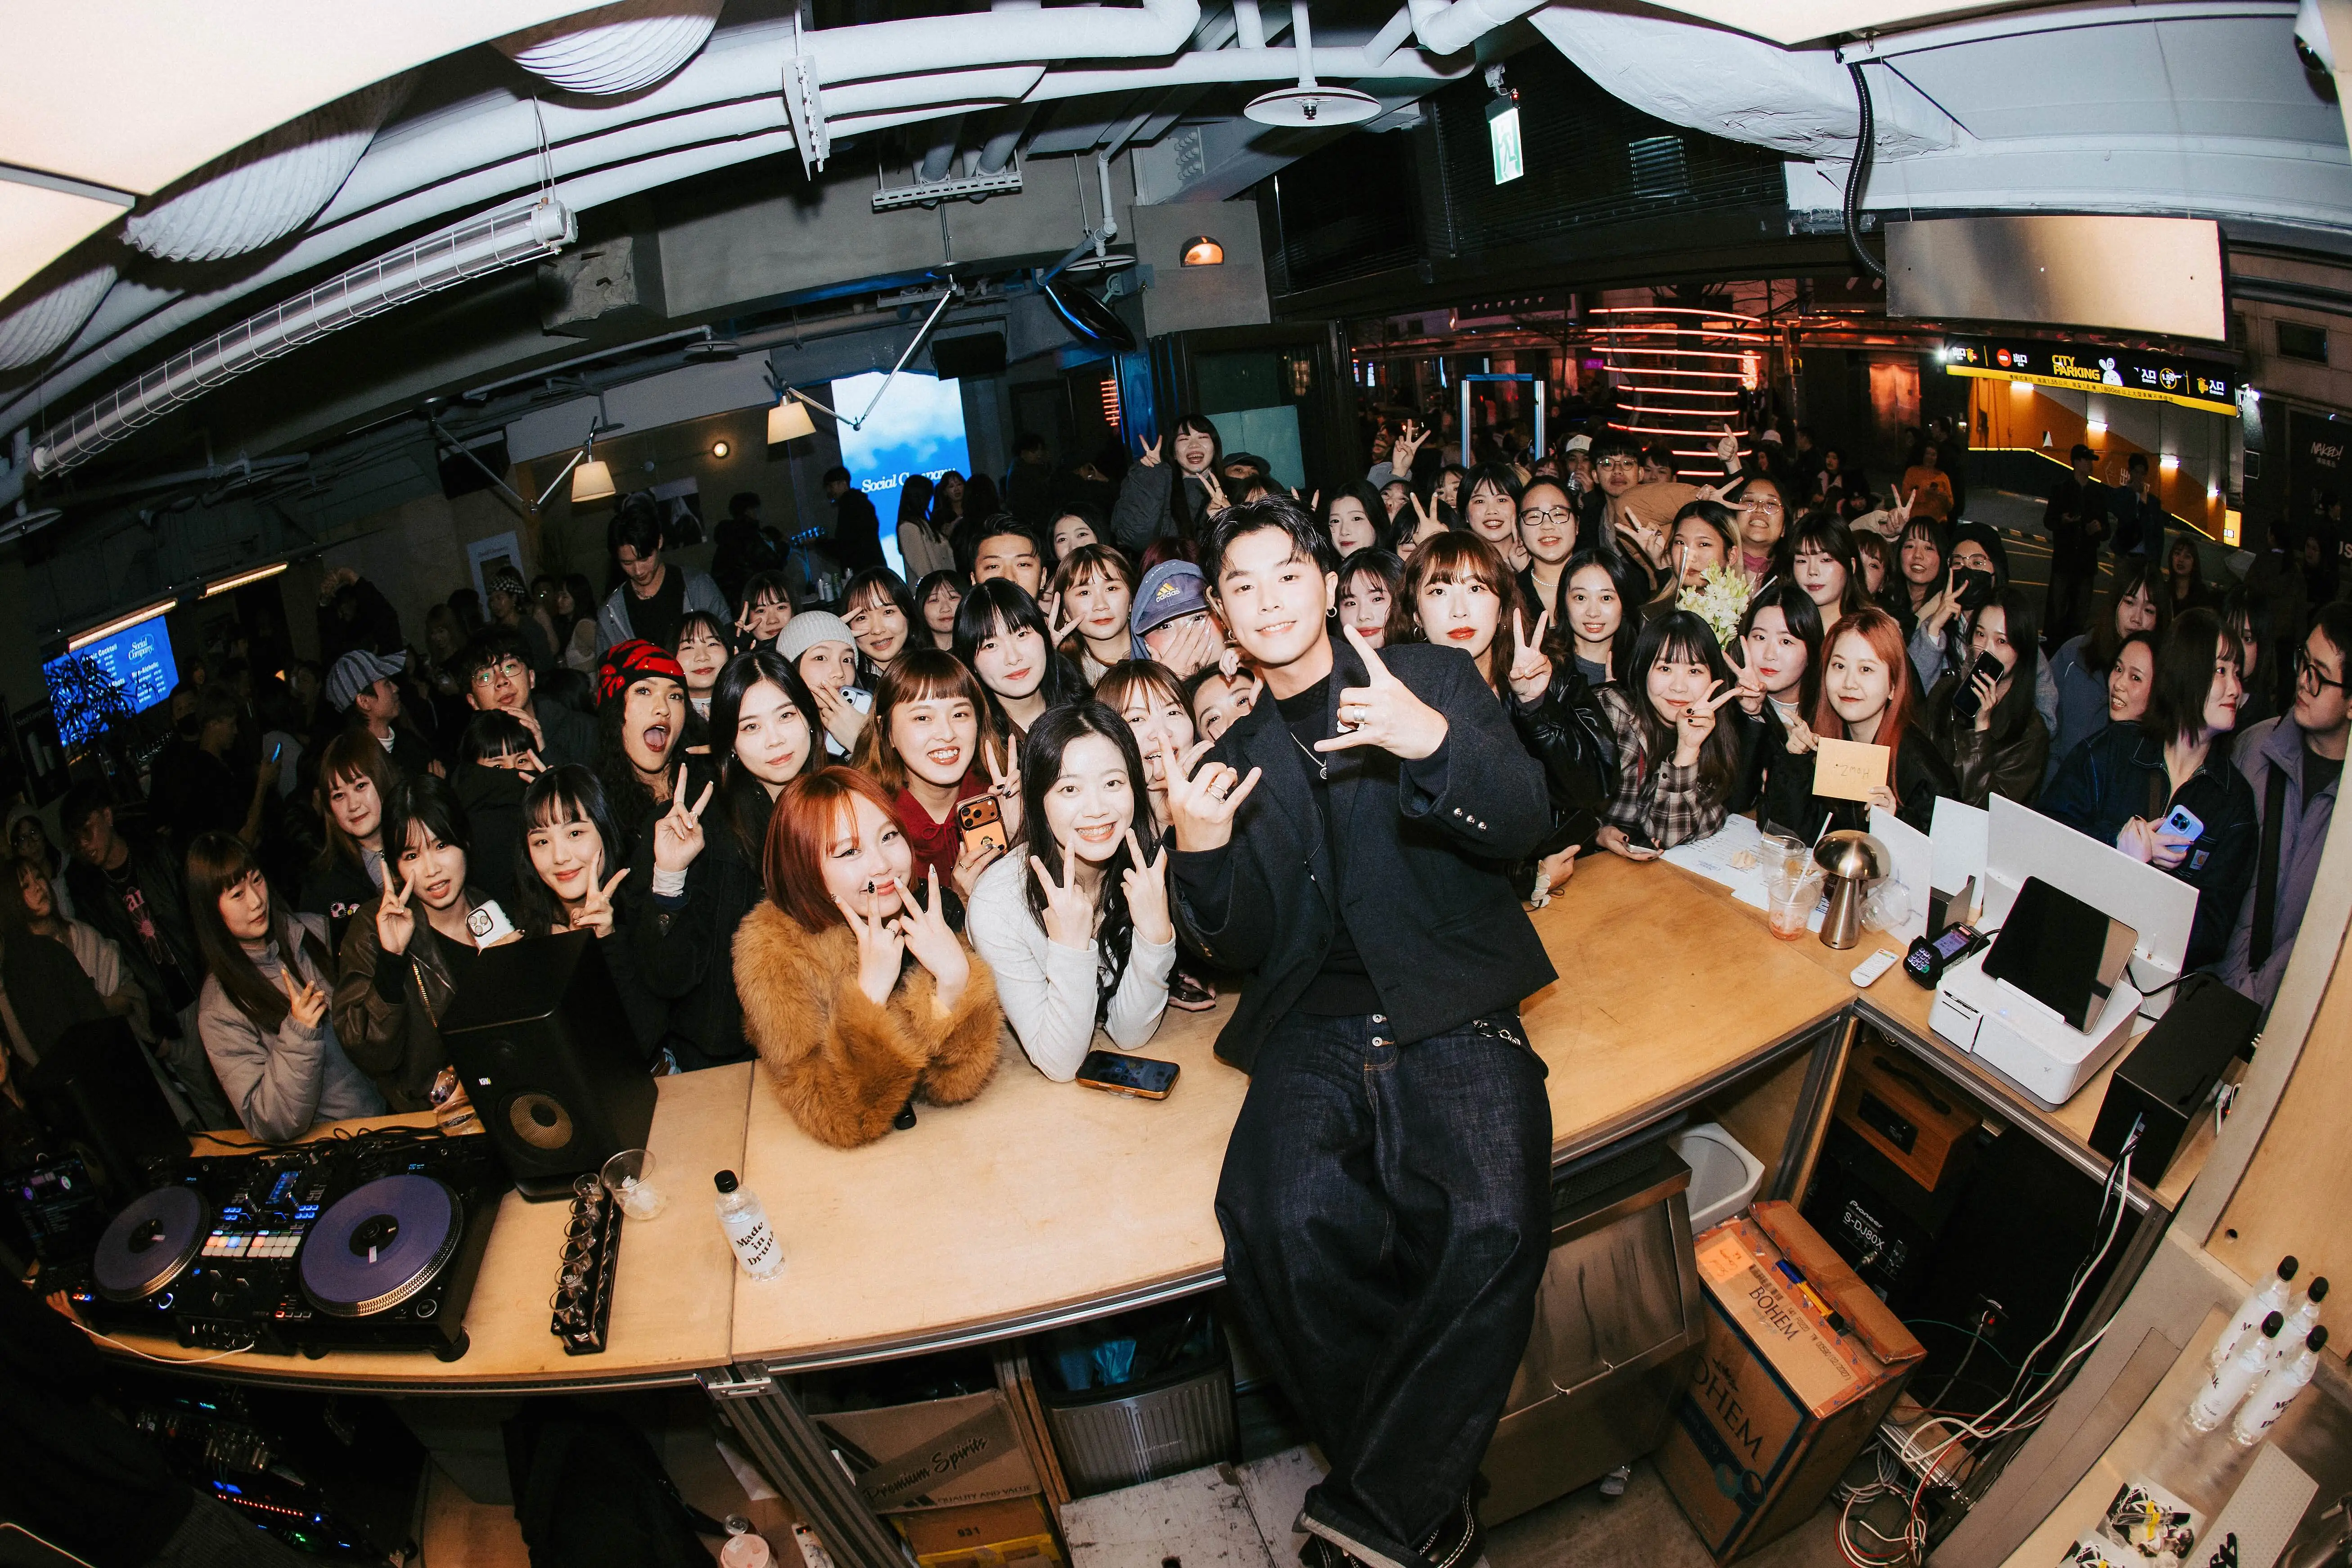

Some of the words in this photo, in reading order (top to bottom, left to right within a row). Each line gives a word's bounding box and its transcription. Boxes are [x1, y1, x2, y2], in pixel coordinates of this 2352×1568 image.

[2052, 355, 2075, 367] CITY
[2053, 364, 2100, 380] PARKING
[2141, 369, 2156, 379] 入口
[2209, 380, 2224, 392] 入口
[2311, 442, 2344, 460] NAKED!
[861, 474, 897, 493] Social
[1156, 589, 1181, 603] adidas
[98, 643, 117, 657] Cocktail
[132, 637, 148, 650] Social
[1849, 1200, 1883, 1228] Pioneer
[736, 1221, 764, 1248] Made
[1844, 1212, 1885, 1246] S-DJ80X
[751, 1237, 765, 1250] in
[1748, 1286, 1801, 1341] BOHEM
[1692, 1356, 1764, 1463] OHEM
[862, 1466, 931, 1501] Premium
[931, 1436, 988, 1473] Spirits
[937, 1492, 977, 1505] QUALITY
[980, 1489, 1001, 1499] AND
[1002, 1486, 1032, 1495] VALUE
